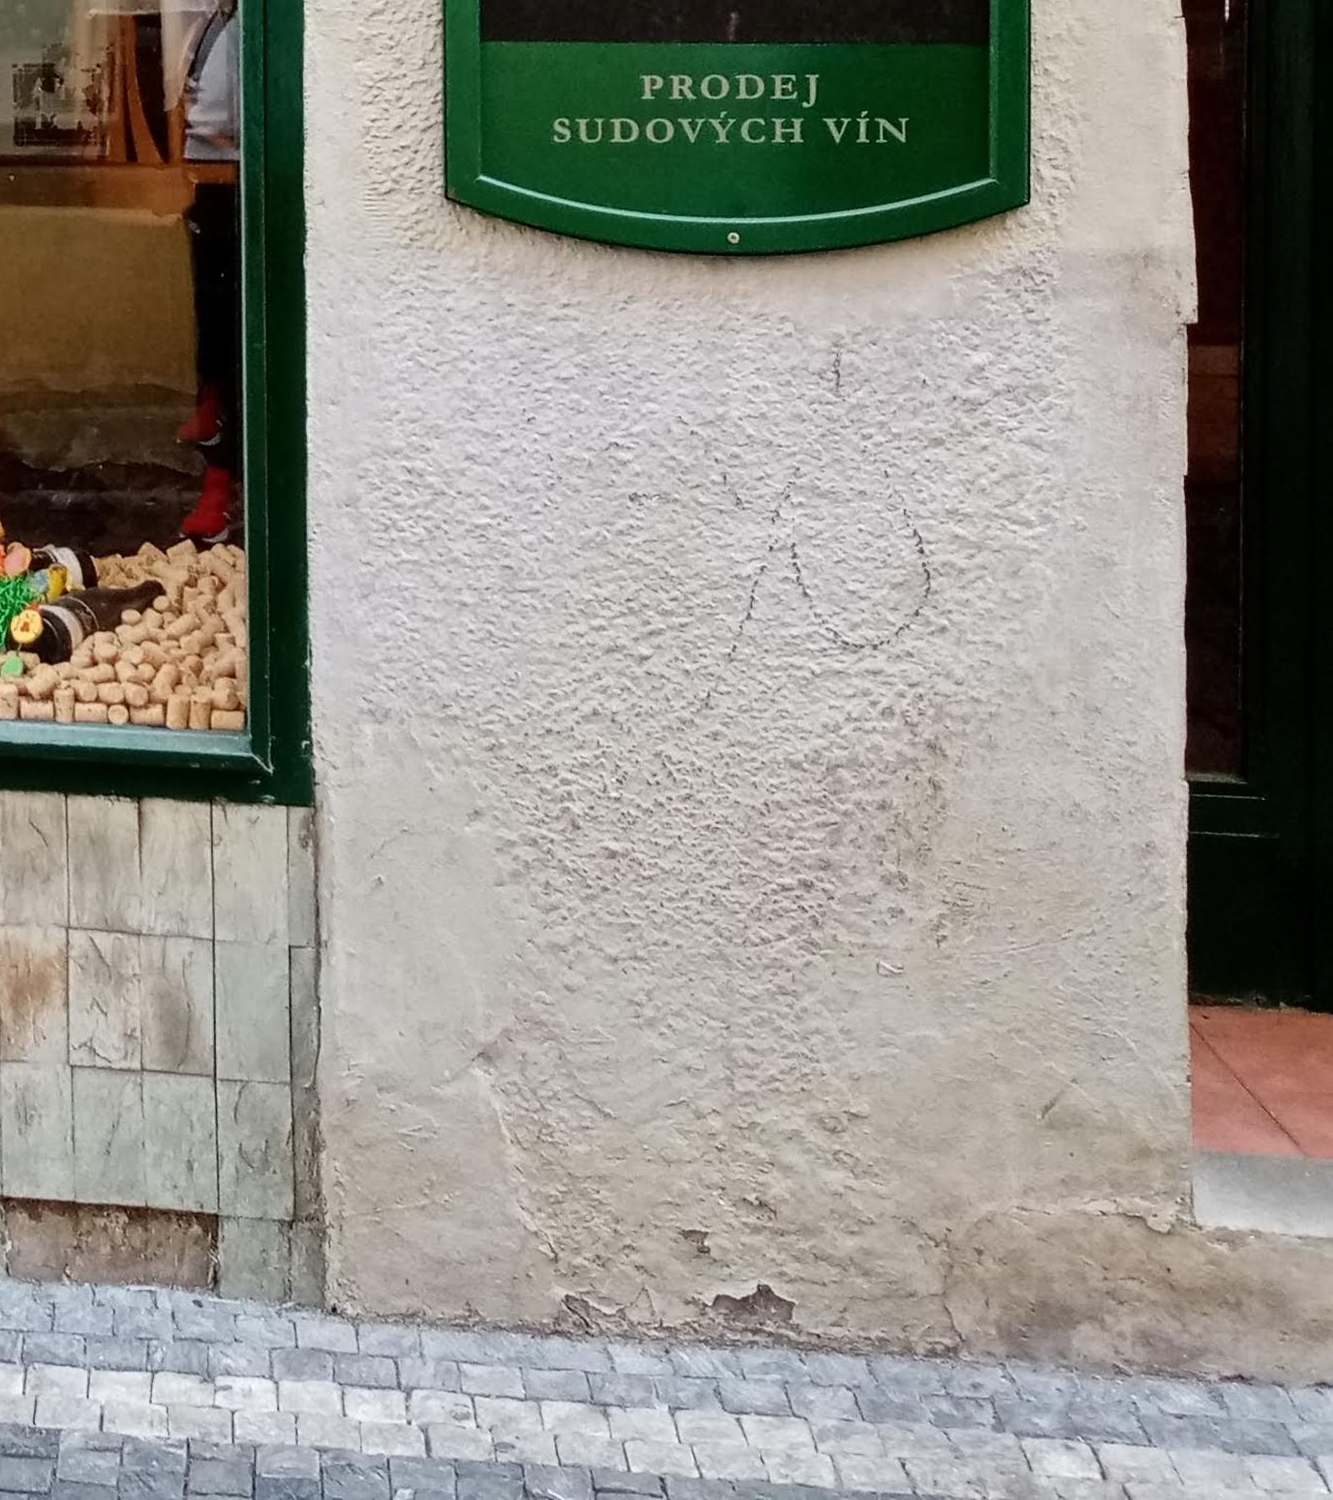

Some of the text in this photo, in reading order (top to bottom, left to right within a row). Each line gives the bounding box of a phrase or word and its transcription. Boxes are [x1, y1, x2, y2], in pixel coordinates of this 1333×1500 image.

[639, 72, 820, 108] PRODEJ
[552, 110, 910, 145] SUDOVÝCH VÍN
